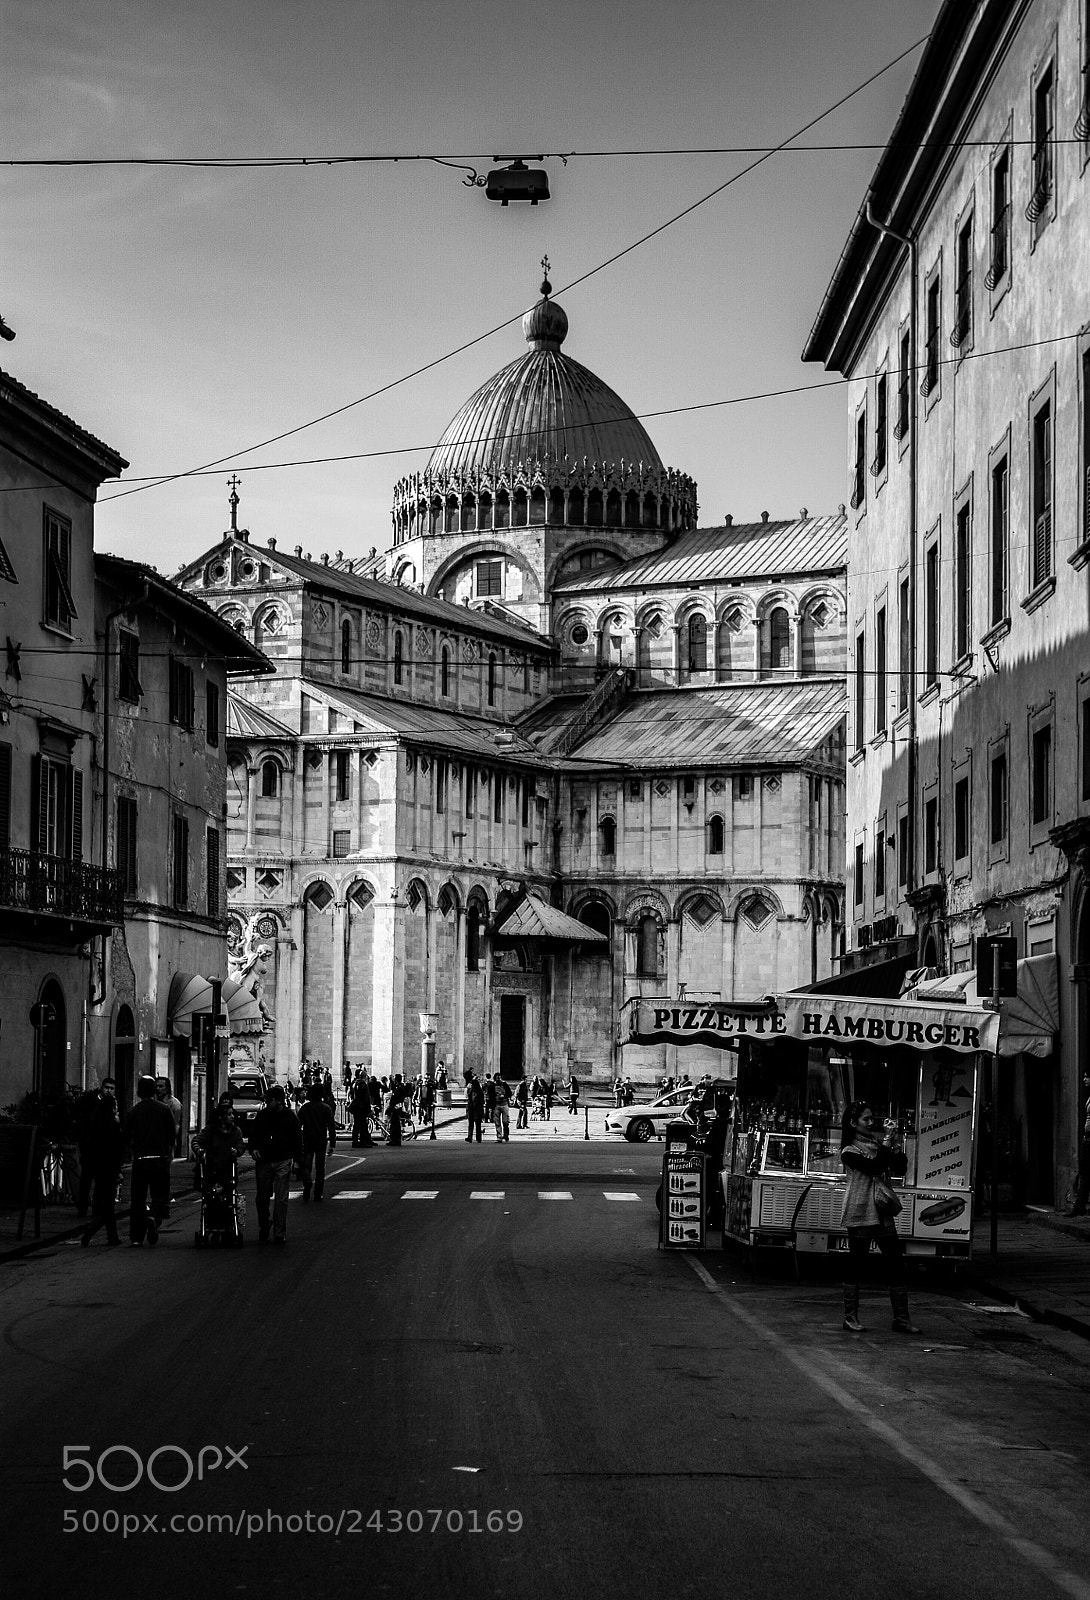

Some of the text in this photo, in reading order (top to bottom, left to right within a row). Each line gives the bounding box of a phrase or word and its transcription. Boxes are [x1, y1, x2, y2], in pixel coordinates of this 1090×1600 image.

[653, 1008, 981, 1048] PIZZETTE HAMBURGER
[920, 1110, 972, 1135] HAMBURGER
[931, 1130, 960, 1146] BIBITE
[929, 1146, 960, 1162] PANINI
[925, 1161, 963, 1180] HOT DOG
